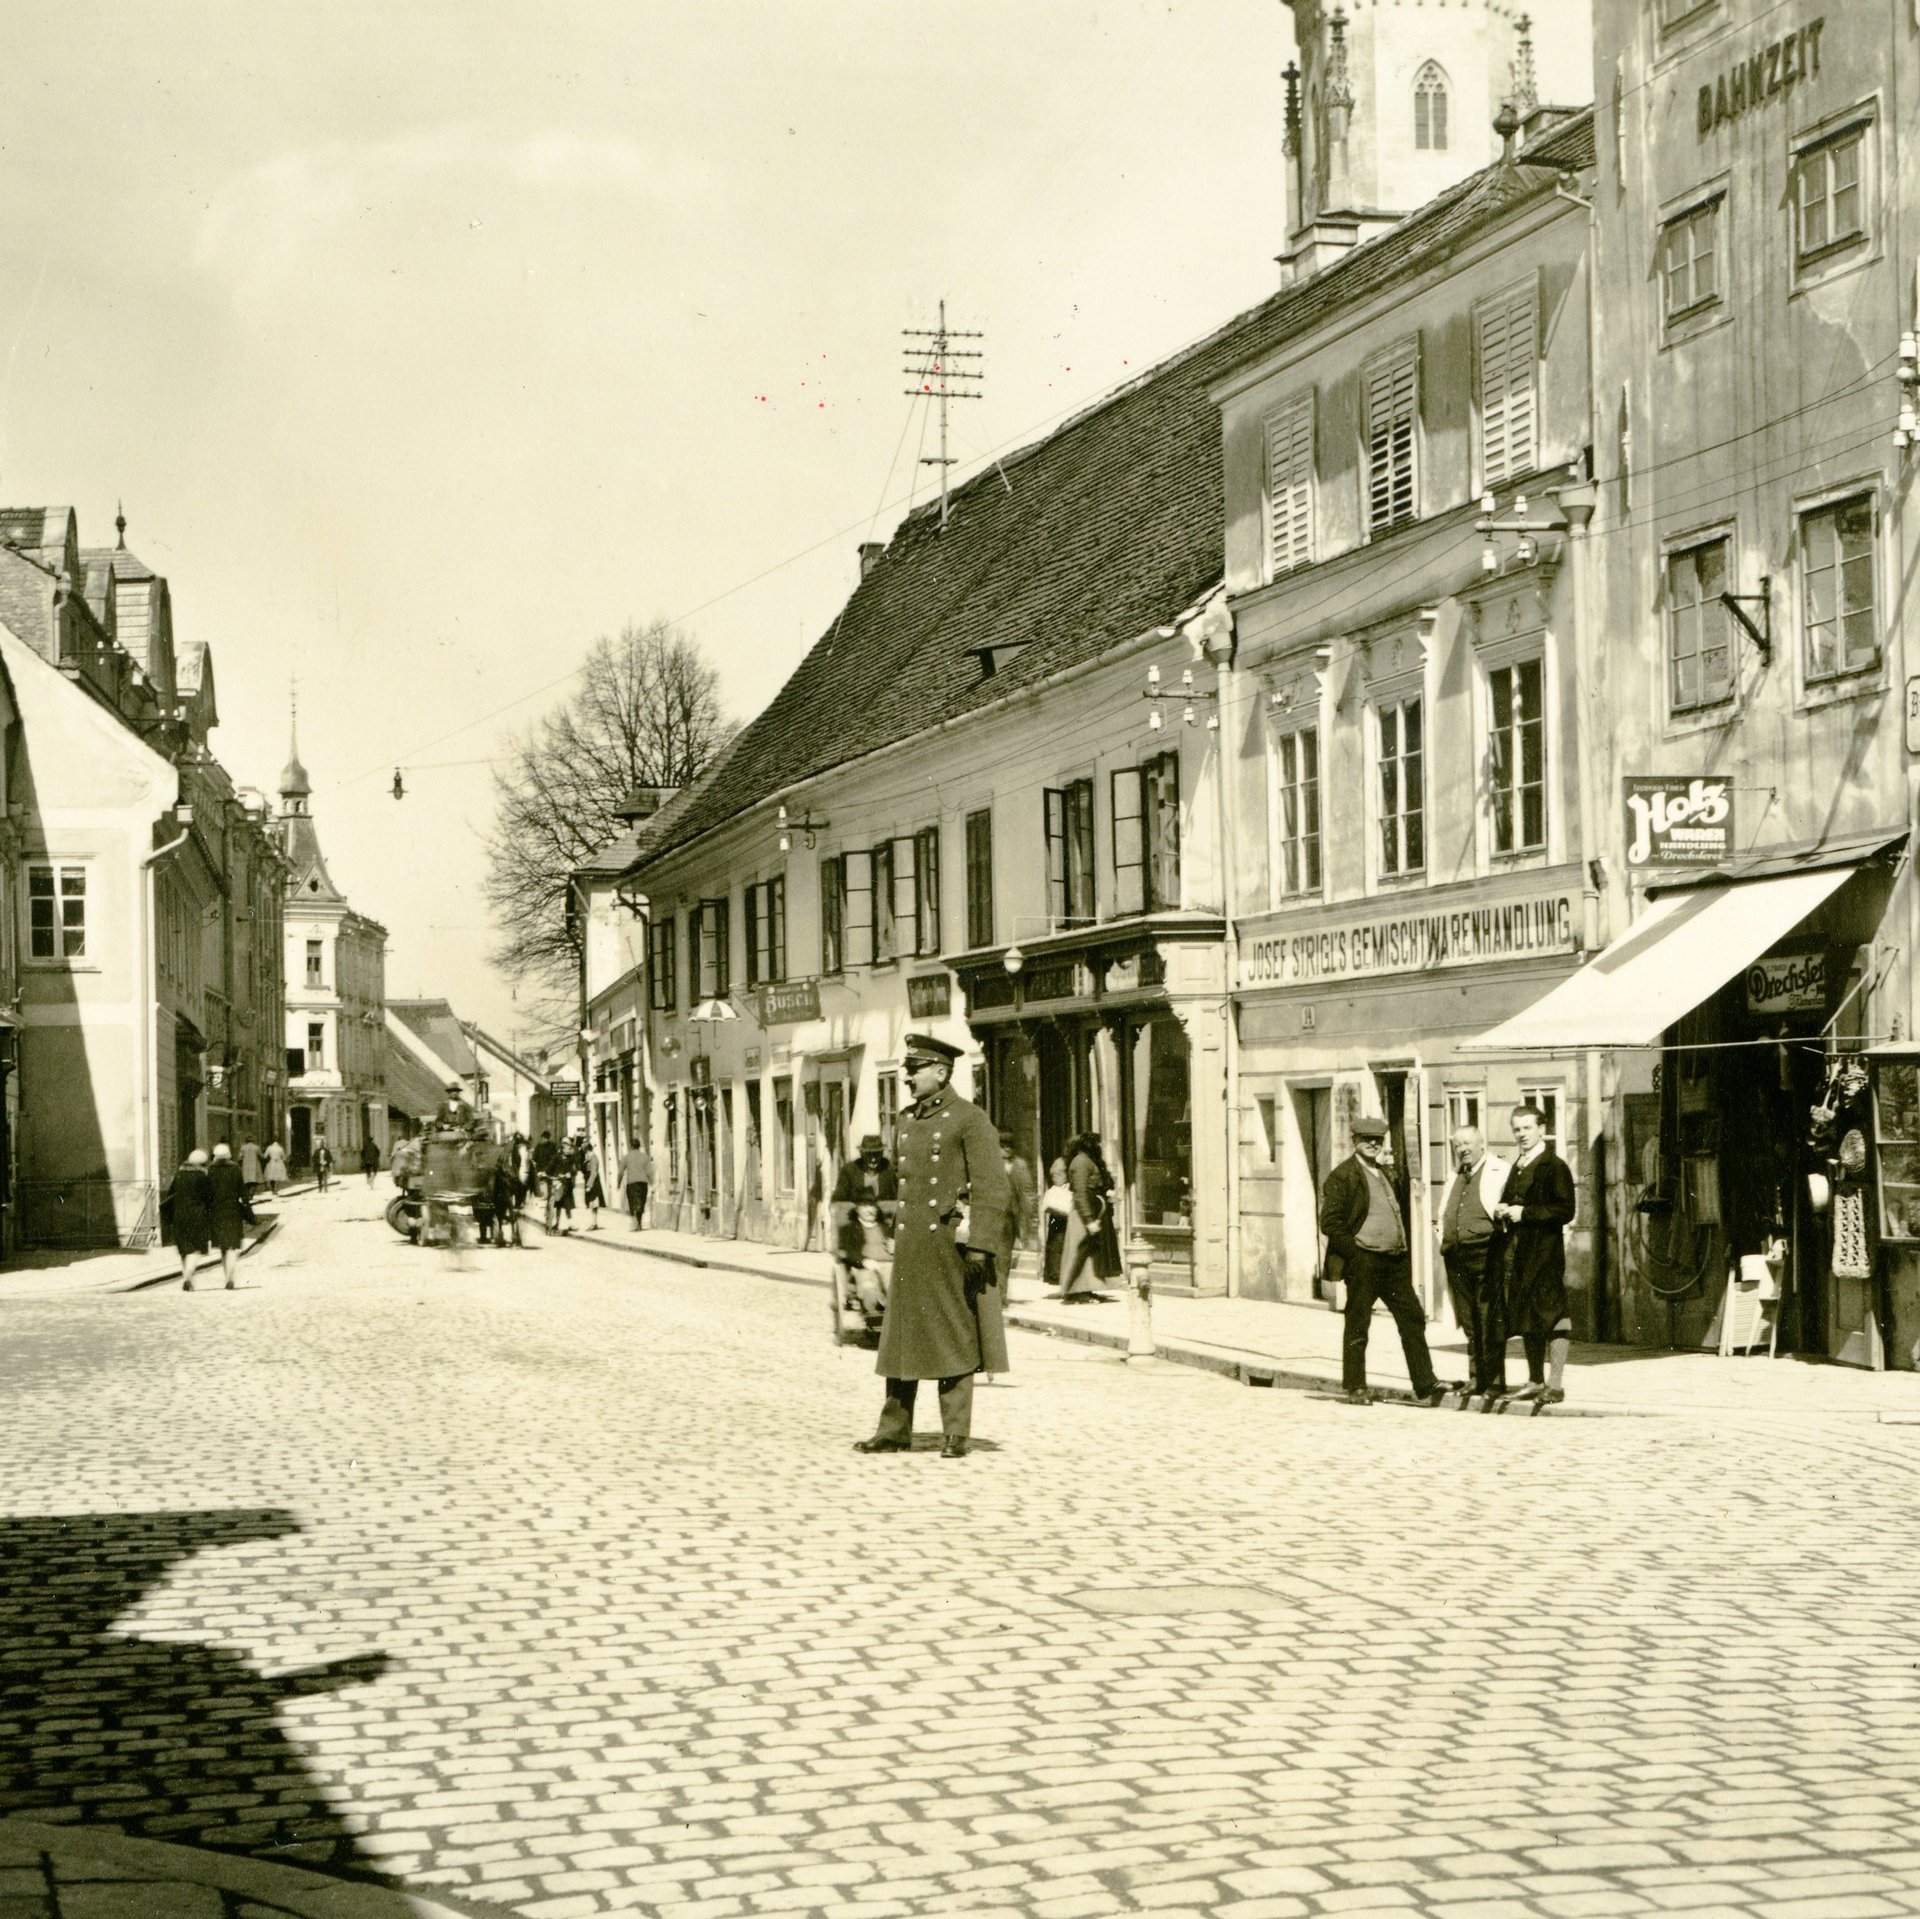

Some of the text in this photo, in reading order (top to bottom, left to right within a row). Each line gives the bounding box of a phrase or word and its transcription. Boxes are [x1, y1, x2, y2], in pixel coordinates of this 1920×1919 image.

[1698, 17, 1824, 136] BAHNZEIT
[1627, 779, 1730, 864] Holz
[1659, 841, 1727, 850] HANDLUNG
[1669, 828, 1726, 841] WAREN
[1248, 897, 1570, 981] JOSEF STRIGL'S GEMISCHTWARENHANDLUNG
